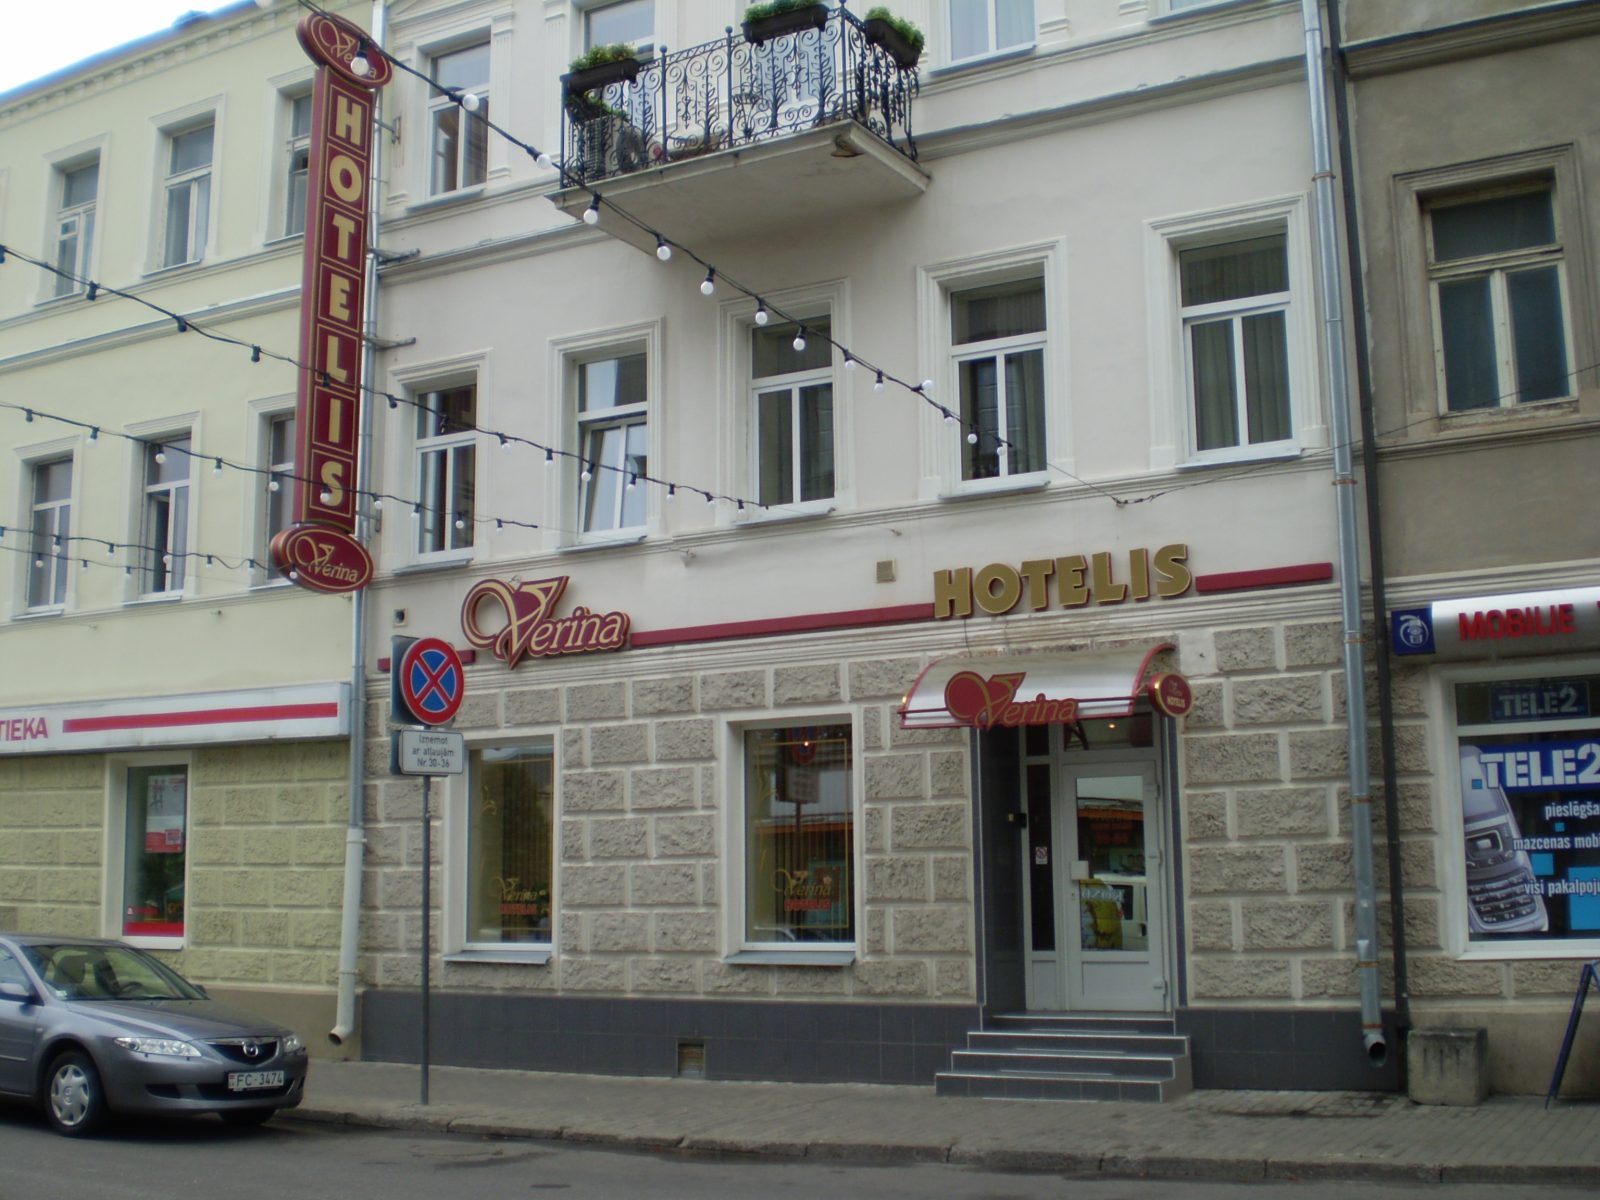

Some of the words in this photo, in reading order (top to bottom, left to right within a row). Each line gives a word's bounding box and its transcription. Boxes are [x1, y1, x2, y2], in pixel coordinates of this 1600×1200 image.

[319, 20, 377, 79] Vea
[320, 95, 362, 507] HOTELIS
[295, 536, 358, 582] Verina
[934, 544, 1192, 618] HOTELIS
[462, 578, 626, 664] Verina
[1458, 603, 1577, 640] MOBILIE
[946, 672, 1077, 728] Verina
[1499, 684, 1578, 716] TELE2
[1480, 743, 1600, 789] TELE2
[1513, 835, 1571, 849] mazcenas
[1525, 879, 1544, 894] visi
